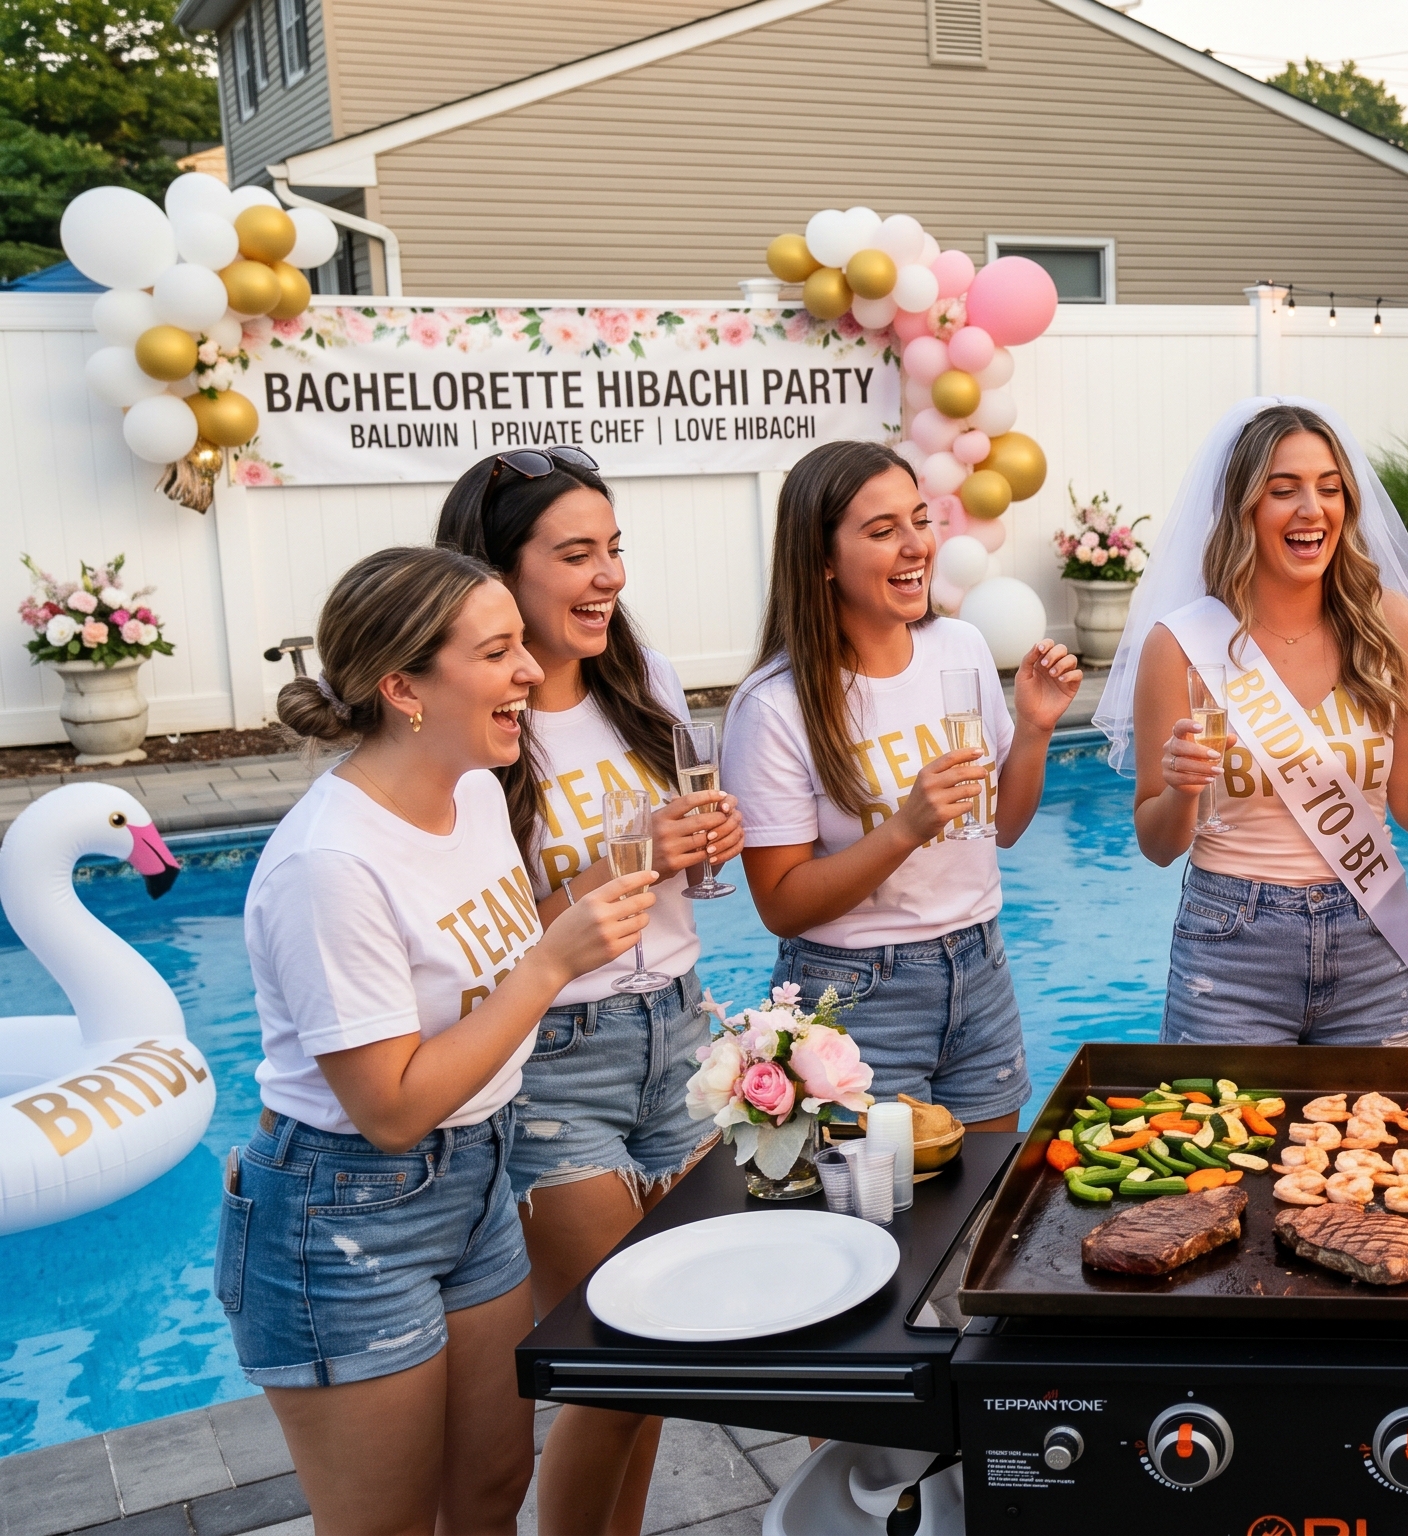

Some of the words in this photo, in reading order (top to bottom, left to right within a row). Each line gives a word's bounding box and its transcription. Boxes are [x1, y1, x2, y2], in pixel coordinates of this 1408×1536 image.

[263, 370, 585, 413] BACHELORETTE
[596, 369, 749, 409] HIBACHI
[762, 367, 875, 405] PARTY
[350, 422, 459, 448] BALDWIN
[490, 420, 583, 446] PRIVATE
[590, 419, 645, 444] CHEF
[674, 417, 728, 442] LOVE
[734, 415, 816, 440] HIBACHI
[1227, 668, 1389, 894] BRIDE-TO-BE
[11, 1039, 208, 1158] BRIDE
